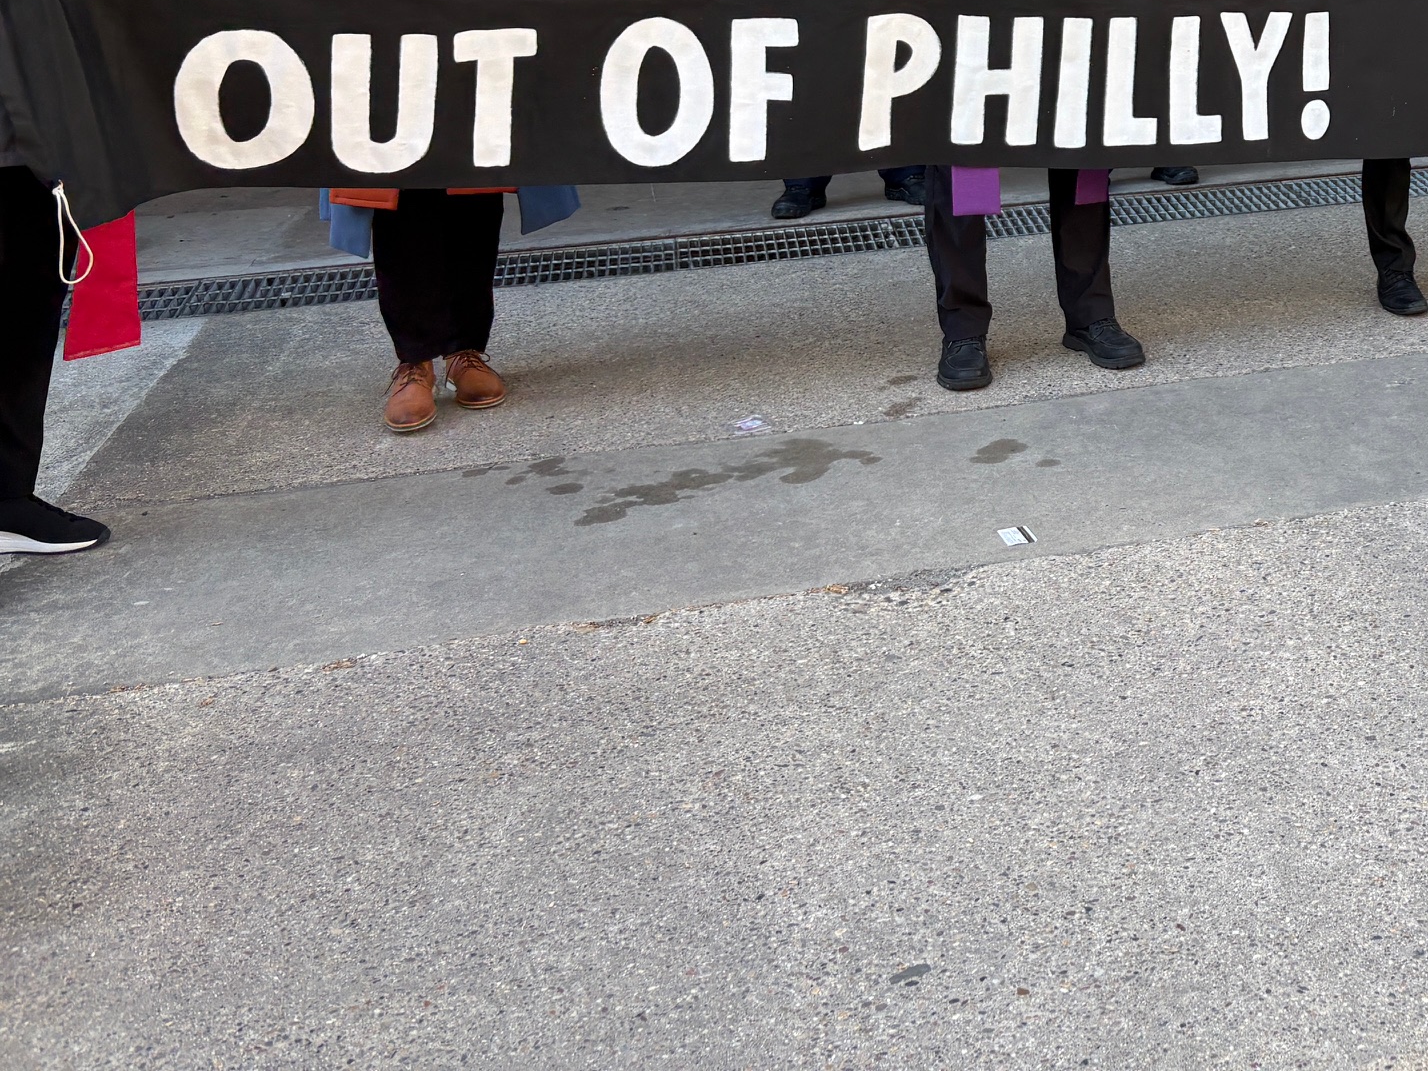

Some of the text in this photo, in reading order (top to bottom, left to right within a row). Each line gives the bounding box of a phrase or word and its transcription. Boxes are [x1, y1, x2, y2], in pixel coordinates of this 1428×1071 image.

[173, 11, 1331, 173] OUT OF PHILLY!
